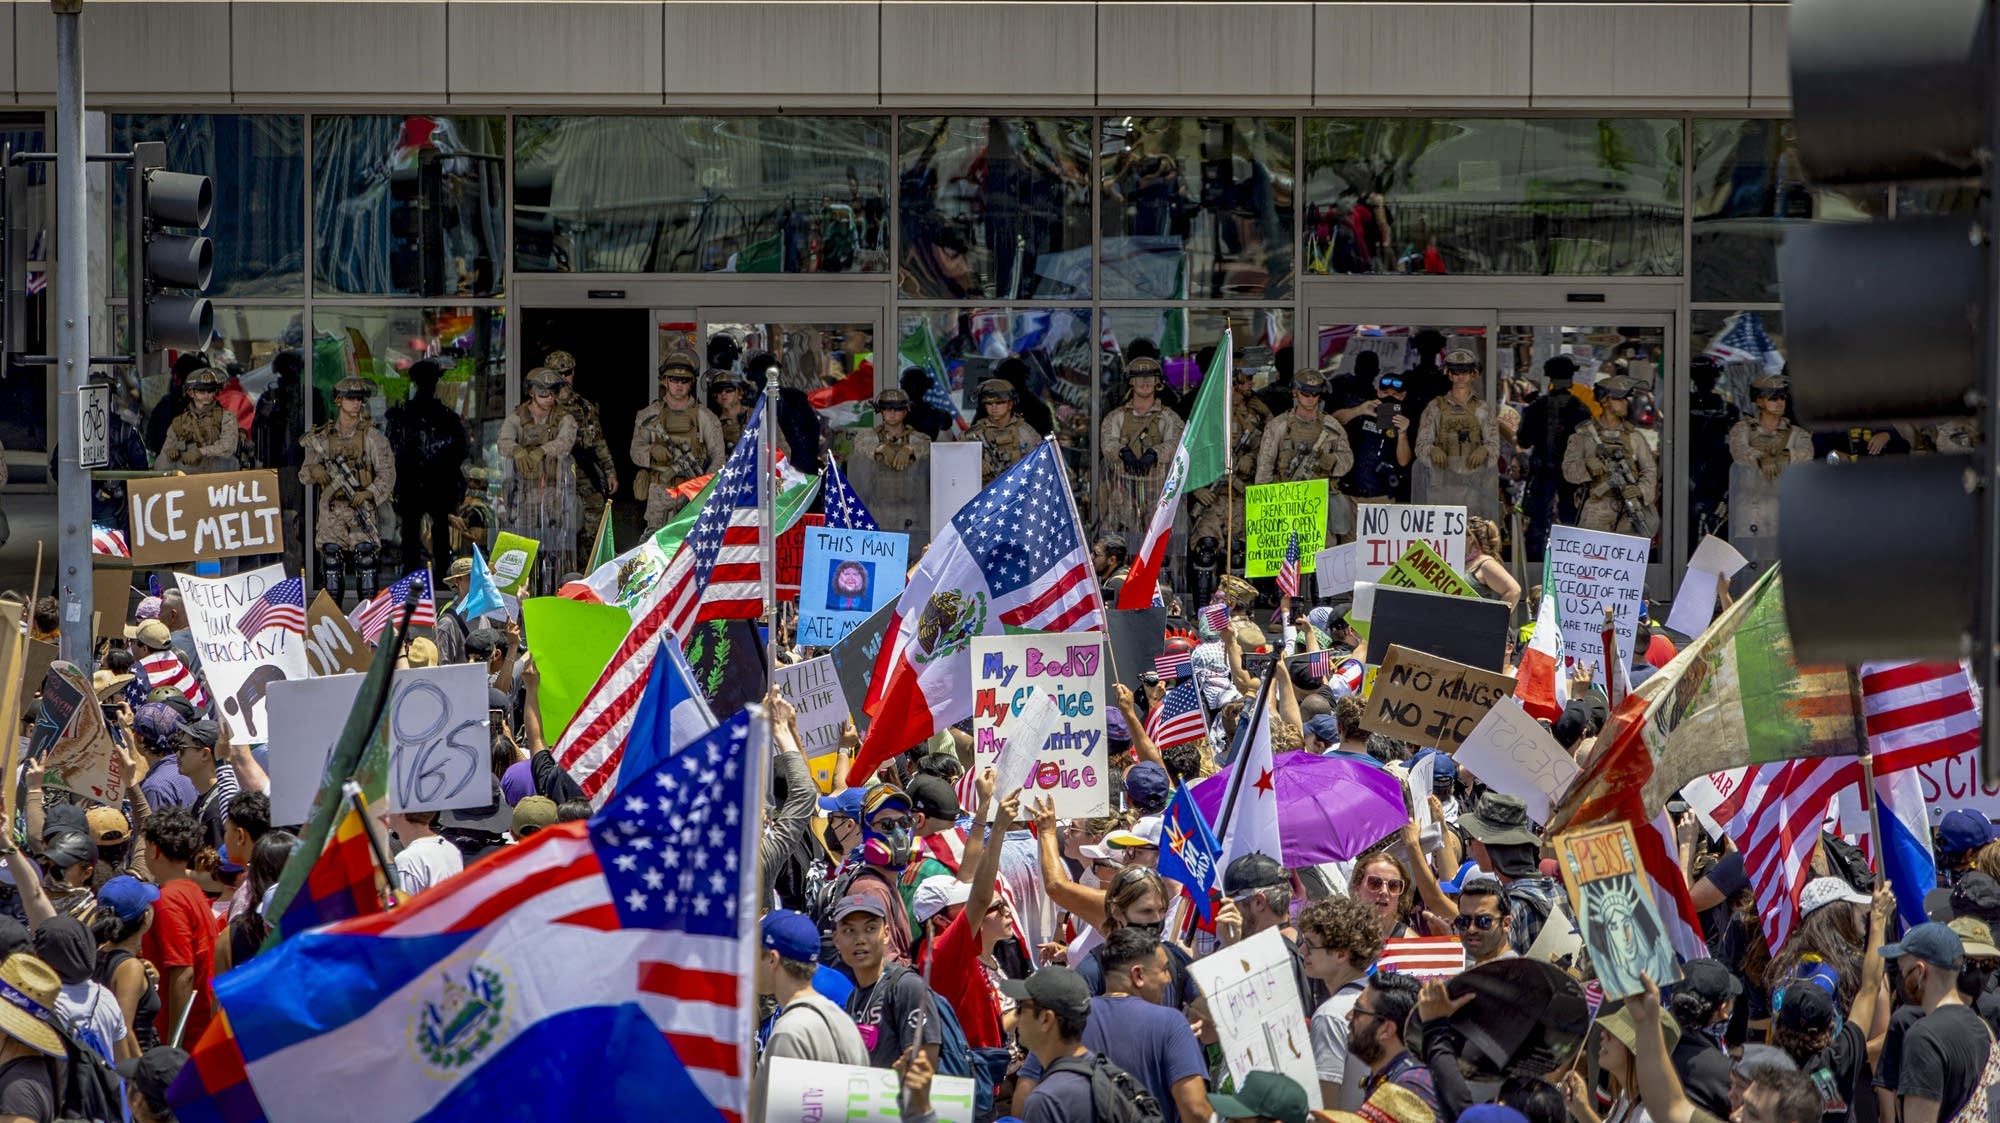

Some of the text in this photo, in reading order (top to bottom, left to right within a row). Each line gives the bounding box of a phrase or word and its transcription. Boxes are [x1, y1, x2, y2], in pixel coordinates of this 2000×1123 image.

[132, 480, 268, 547] ICE WILL
[1292, 514, 1316, 533] OPEN
[1362, 507, 1465, 536] NO ONE IS
[194, 507, 280, 555] MELT
[817, 533, 896, 557] THIS MAN
[1265, 559, 1283, 573] READ
[1366, 539, 1452, 567] ILLAL
[1582, 543, 1611, 557] OUT
[1611, 547, 1626, 560] OF
[1405, 549, 1464, 596] AMERICA
[1576, 565, 1598, 577] OUT
[1598, 568, 1613, 579] OF
[1613, 569, 1629, 582] CA
[180, 574, 266, 608] PRETEND
[1576, 582, 1600, 597] OUT
[1600, 587, 1614, 598] OF
[1618, 588, 1639, 601] THE
[200, 609, 237, 638] YOUR
[804, 616, 834, 639] ATE
[1563, 620, 1581, 631] ARE
[1583, 622, 1603, 634] THE
[794, 659, 831, 694] THE
[982, 651, 1018, 688] My
[808, 689, 834, 710] THE
[1389, 664, 1505, 709] NO KINGS
[974, 684, 1095, 728] My Cice
[1378, 697, 1475, 744] NO IC
[977, 727, 1008, 764] My
[1708, 768, 1734, 798] EAR
[1183, 839, 1203, 878] NO
